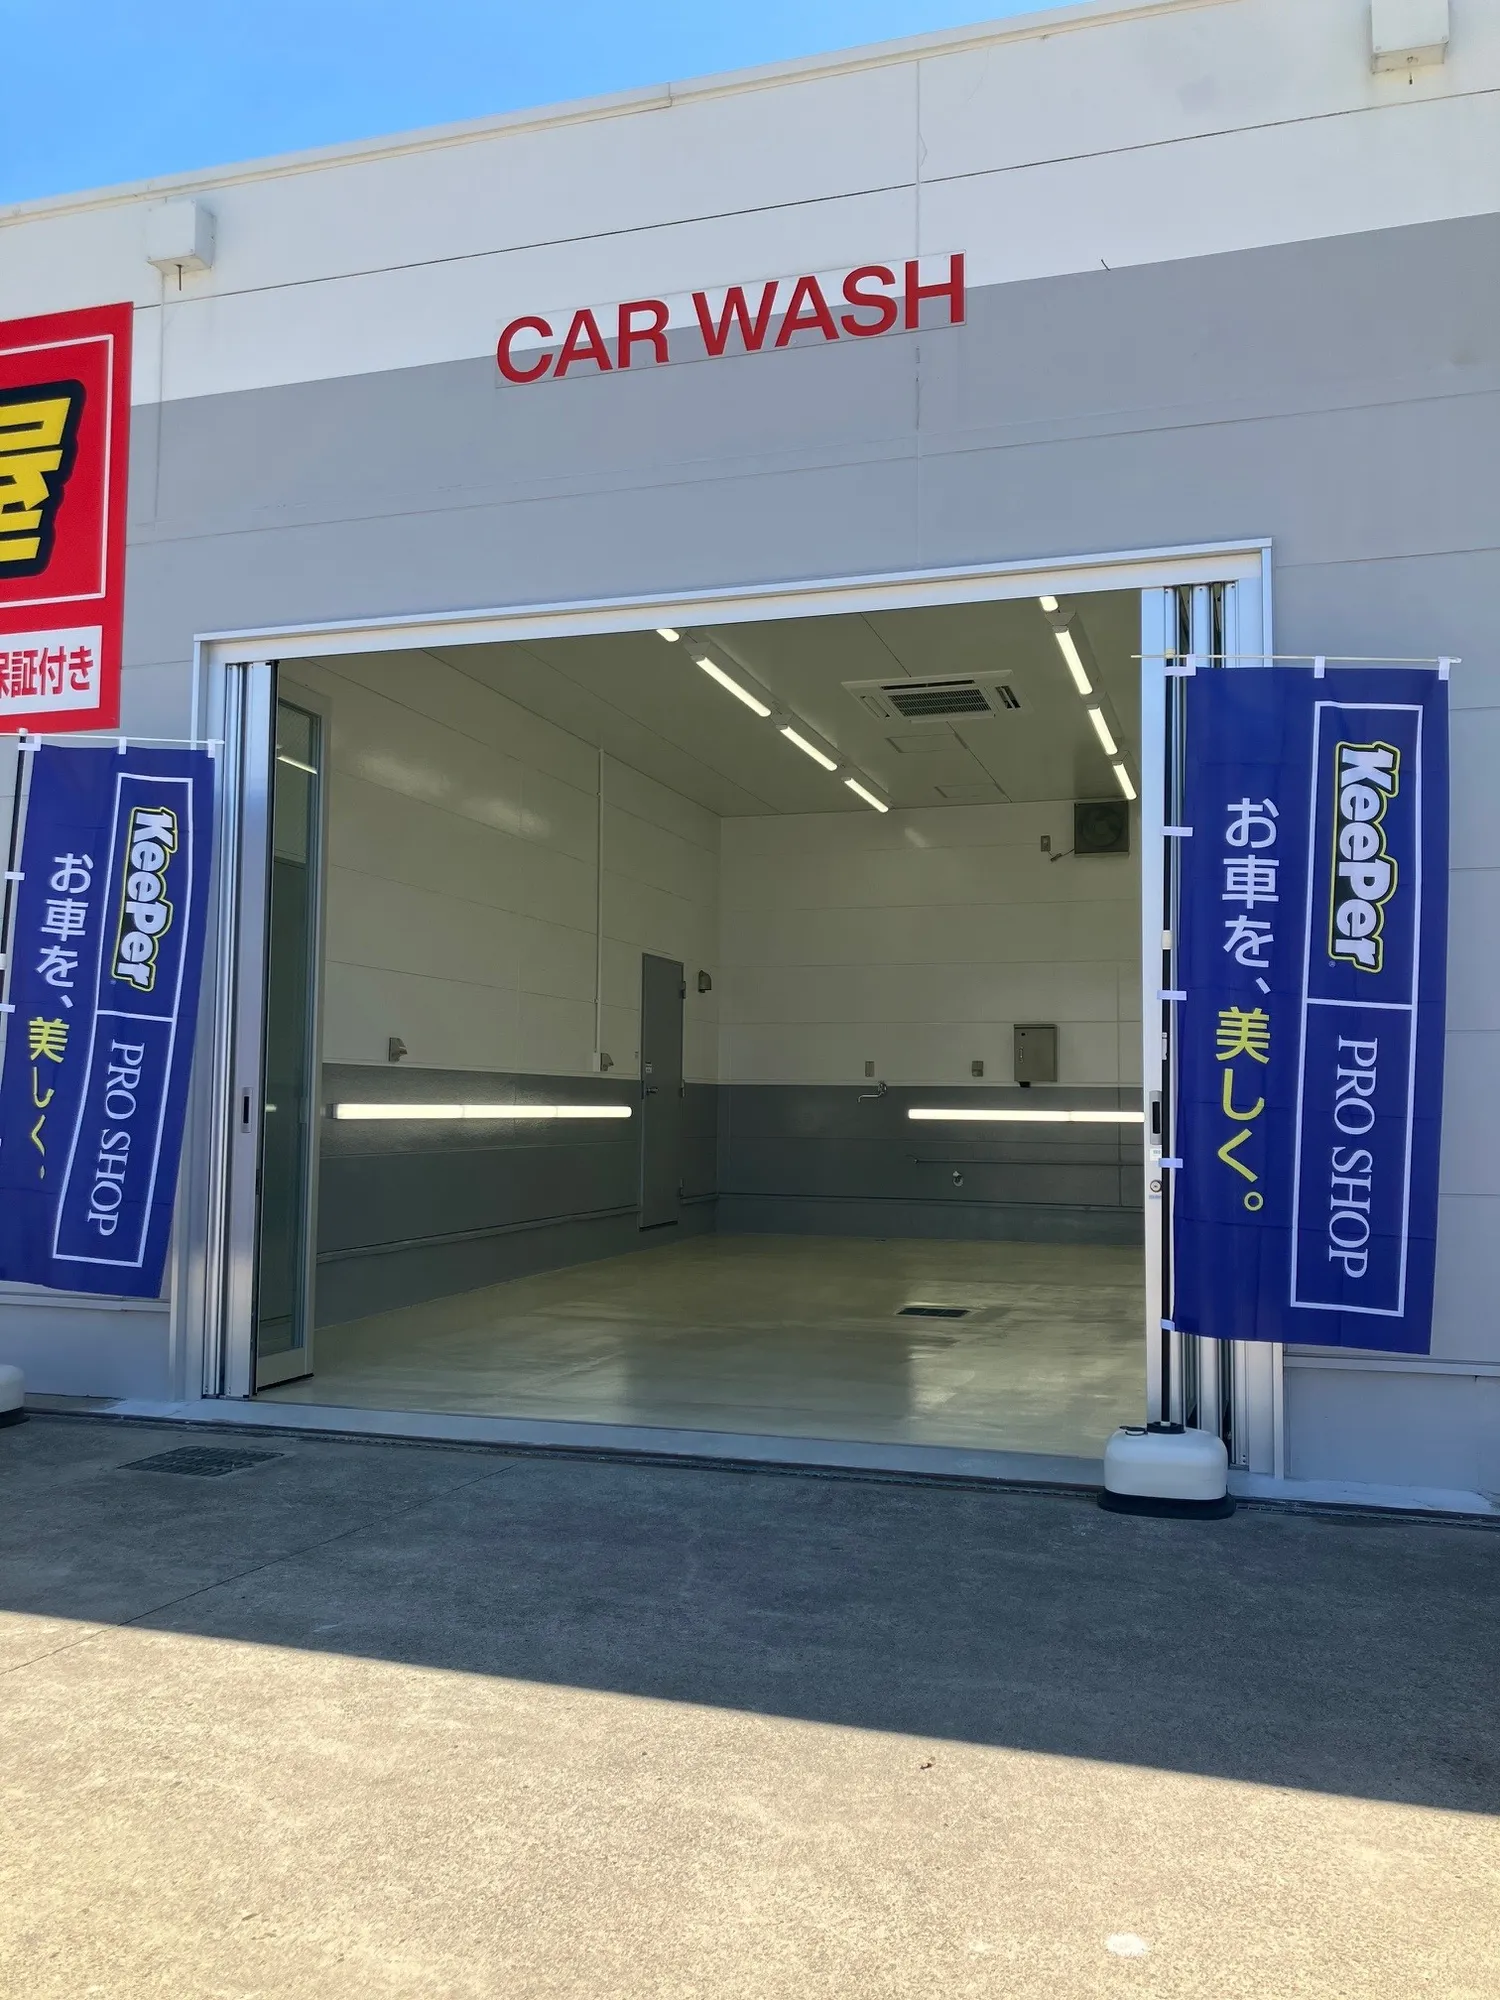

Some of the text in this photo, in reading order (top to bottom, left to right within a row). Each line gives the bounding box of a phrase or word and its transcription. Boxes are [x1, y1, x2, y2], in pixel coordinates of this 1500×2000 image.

[496, 252, 966, 384] CAR WASH
[1215, 797, 1280, 1211] お車を、美しく。
[86, 1039, 146, 1238] PRO SHOP
[1328, 1034, 1378, 1280] PRO SHOP
